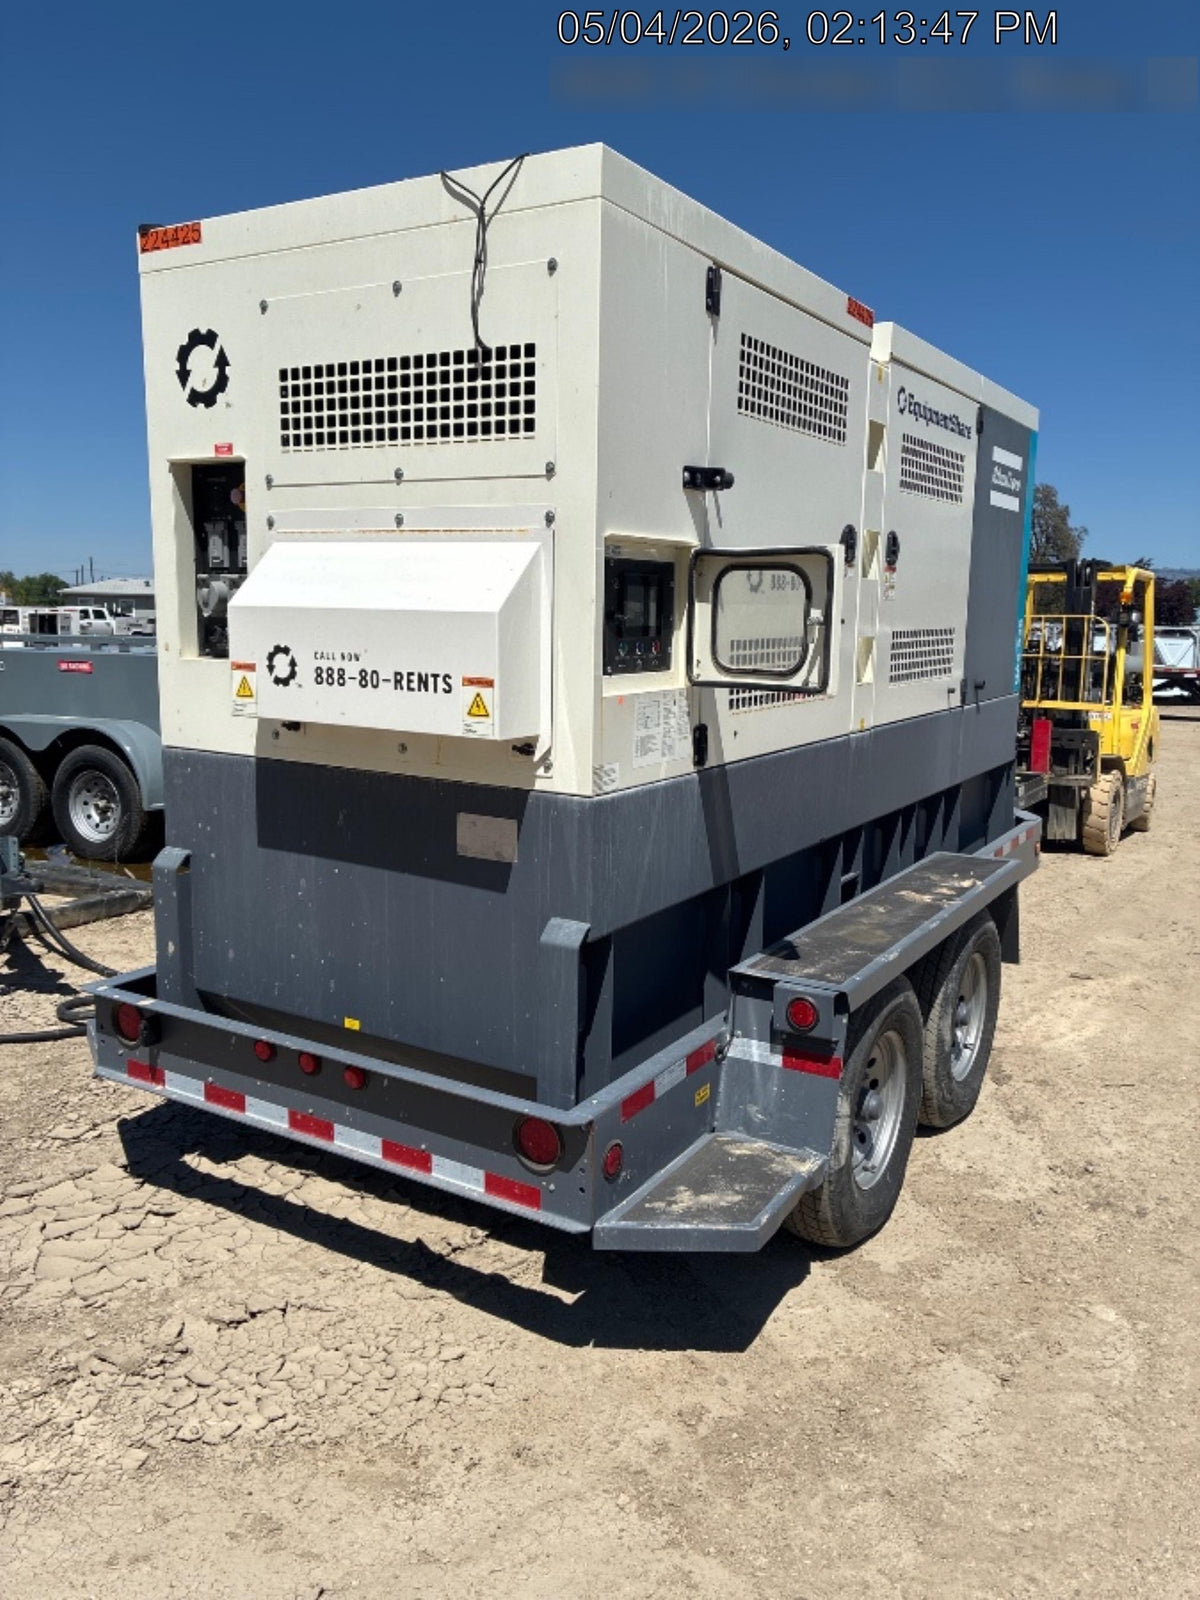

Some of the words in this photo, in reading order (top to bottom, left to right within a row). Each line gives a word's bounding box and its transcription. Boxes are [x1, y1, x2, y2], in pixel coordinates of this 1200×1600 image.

[314, 651, 336, 661] CALL
[341, 651, 361, 662] NOW
[314, 666, 453, 694] 888-80-RENTS
